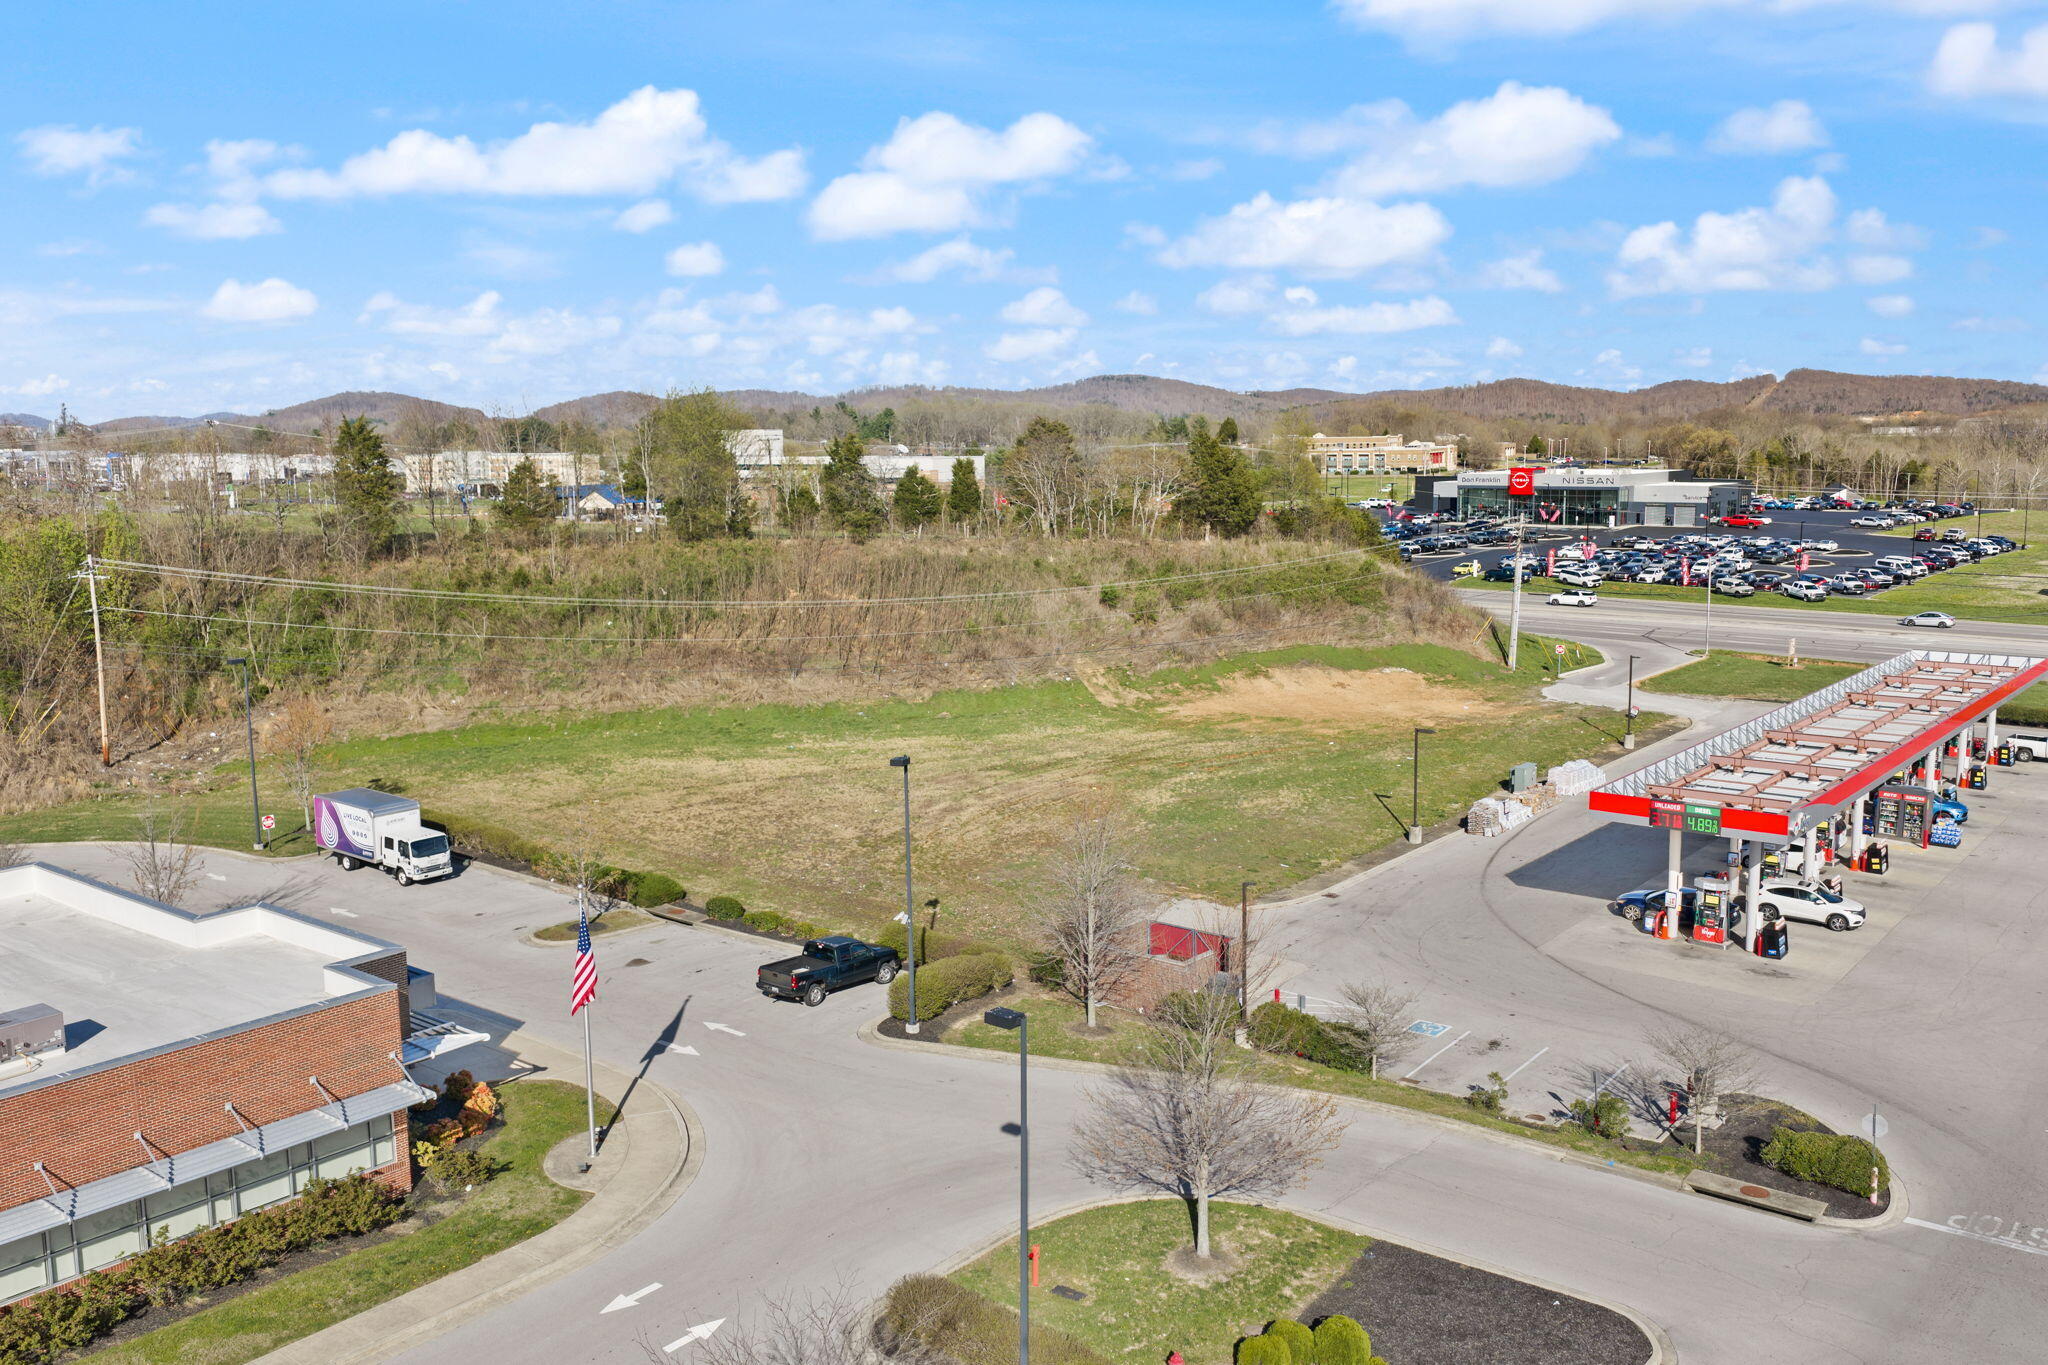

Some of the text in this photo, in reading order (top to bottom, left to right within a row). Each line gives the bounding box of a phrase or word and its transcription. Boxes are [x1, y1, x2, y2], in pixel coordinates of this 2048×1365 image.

[1562, 477, 1615, 485] NISSAN
[1654, 802, 1681, 811] UNLEADED
[353, 815, 367, 823] LOCAL
